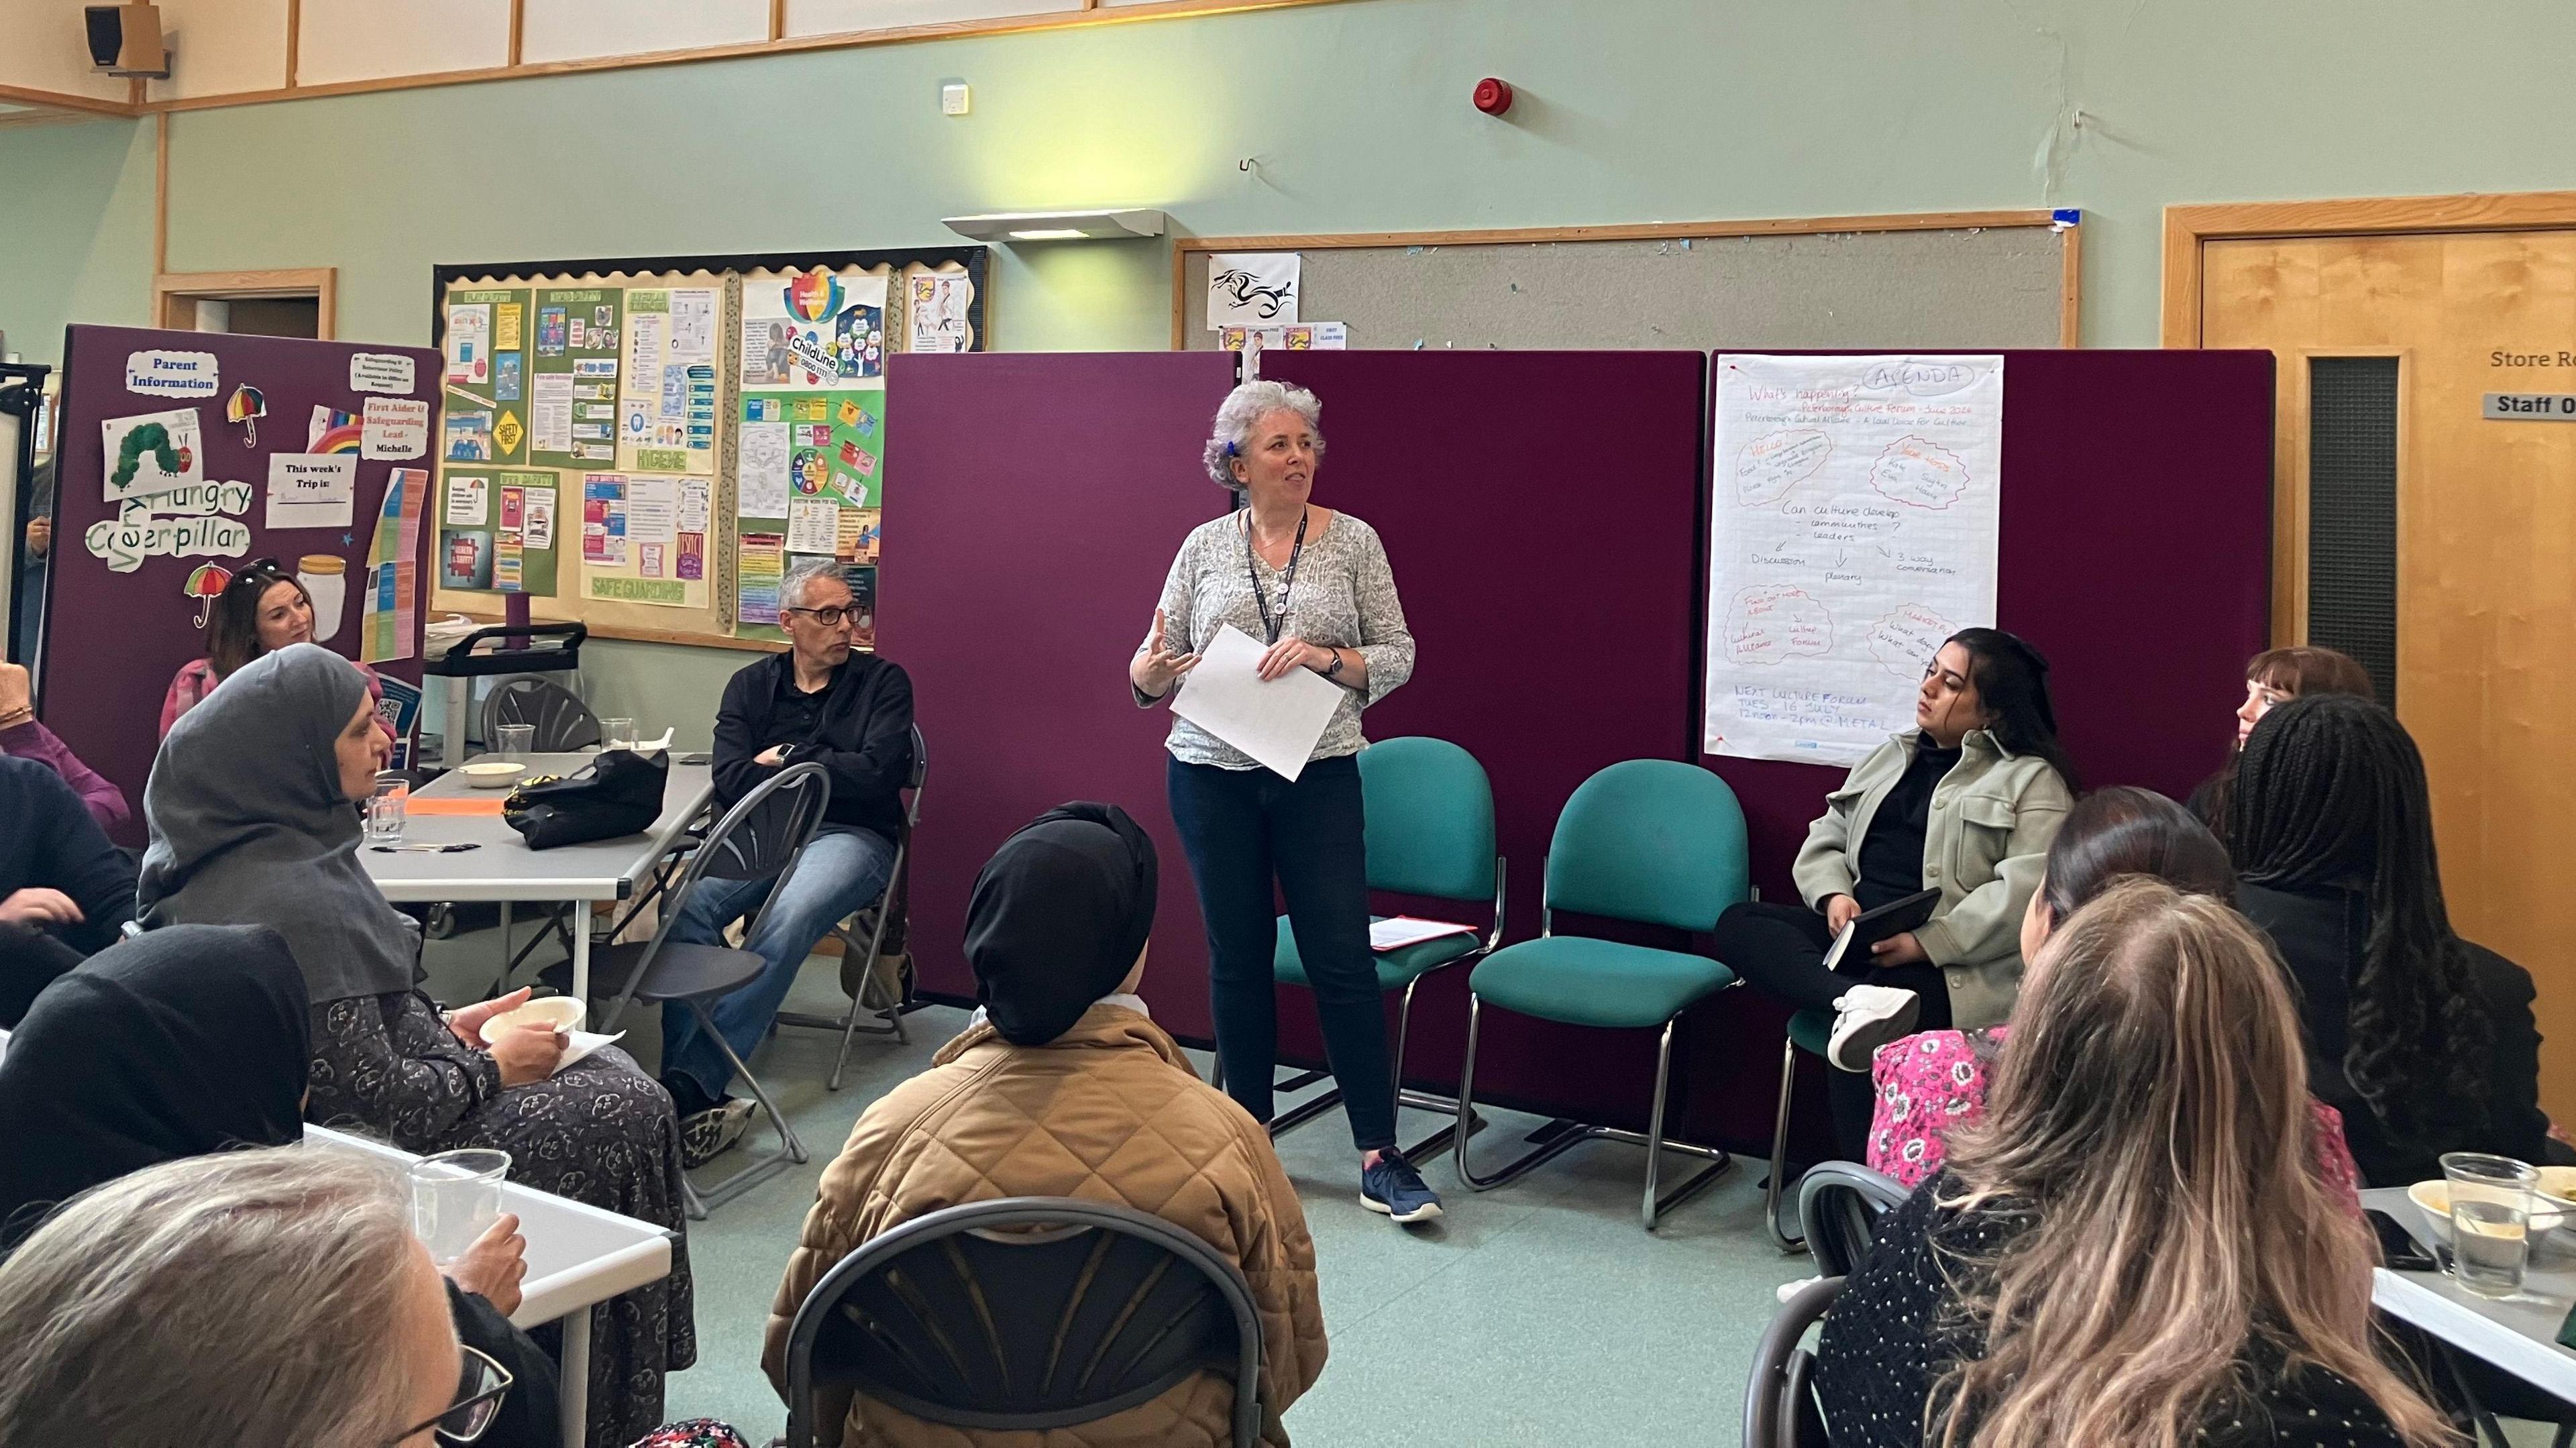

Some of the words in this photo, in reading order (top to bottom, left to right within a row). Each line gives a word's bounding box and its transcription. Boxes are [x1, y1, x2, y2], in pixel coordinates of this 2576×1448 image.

[792, 337, 836, 369] ChildLine
[2490, 351, 2551, 367] Store
[153, 358, 197, 370] Parent
[800, 358, 816, 372] 0800
[816, 368, 828, 378] 1111
[132, 376, 213, 389] Information
[1874, 366, 1961, 387] AGENDA
[1749, 385, 1787, 401] What's
[368, 403, 389, 411] First
[391, 404, 416, 412] Aider
[1854, 403, 1883, 413] Culture
[1886, 403, 1916, 414] Forum
[2497, 395, 2552, 413] Staff
[366, 416, 424, 427] Safeguarding
[383, 430, 403, 438] Lead
[498, 424, 518, 435] SAFETY
[501, 434, 517, 444] FIRST
[376, 444, 412, 452] Michelle
[1750, 439, 1782, 456] HELLO
[286, 465, 307, 473] This
[310, 465, 341, 473] week's
[1888, 457, 1907, 471] Kate
[1880, 469, 1898, 483] Eva
[297, 480, 318, 490] Trip
[1782, 500, 1807, 514] Can
[1813, 504, 1860, 516] culture
[1863, 506, 1900, 520] develop
[1811, 519, 1879, 531] communities
[88, 518, 246, 556] Cerpillar
[1813, 532, 1855, 542] leaders
[455, 546, 473, 555] HEALTH
[456, 555, 474, 564] SAFETY
[1751, 553, 1806, 567] Discussion
[1898, 552, 1905, 561] 3
[1911, 557, 1934, 567] way
[1825, 571, 1862, 586] plenary
[592, 577, 622, 597] SAFE
[1889, 620, 1915, 636] What
[1878, 630, 1904, 649] What
[1735, 684, 1768, 697] NEXT
[1772, 687, 1820, 702] CULTURE
[1823, 693, 1868, 705] FORUM
[1737, 698, 1769, 710] TUES
[1784, 701, 1797, 712] 16
[1807, 702, 1840, 715] JULY
[1839, 716, 1890, 731] METAL
